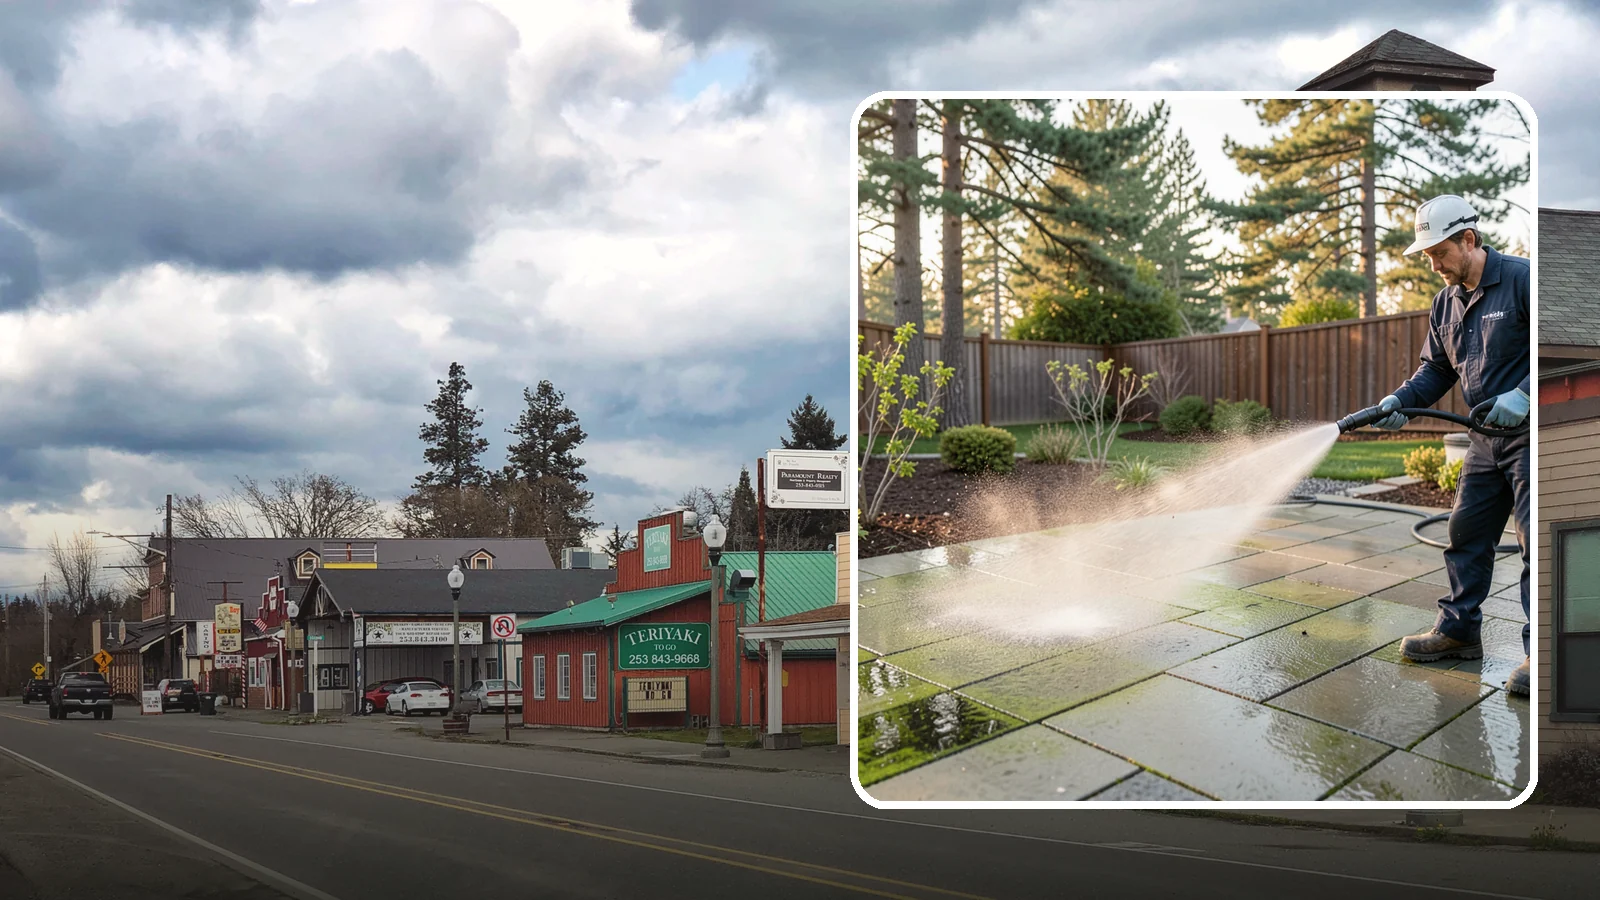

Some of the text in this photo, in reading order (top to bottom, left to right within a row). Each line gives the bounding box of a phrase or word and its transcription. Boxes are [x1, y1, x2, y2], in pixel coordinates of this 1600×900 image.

[781, 471, 839, 480] PARAMOUNT REALTY
[624, 627, 702, 646] TERIYAKI
[654, 643, 677, 651] TO GO
[628, 653, 700, 665] 253 843-9668
